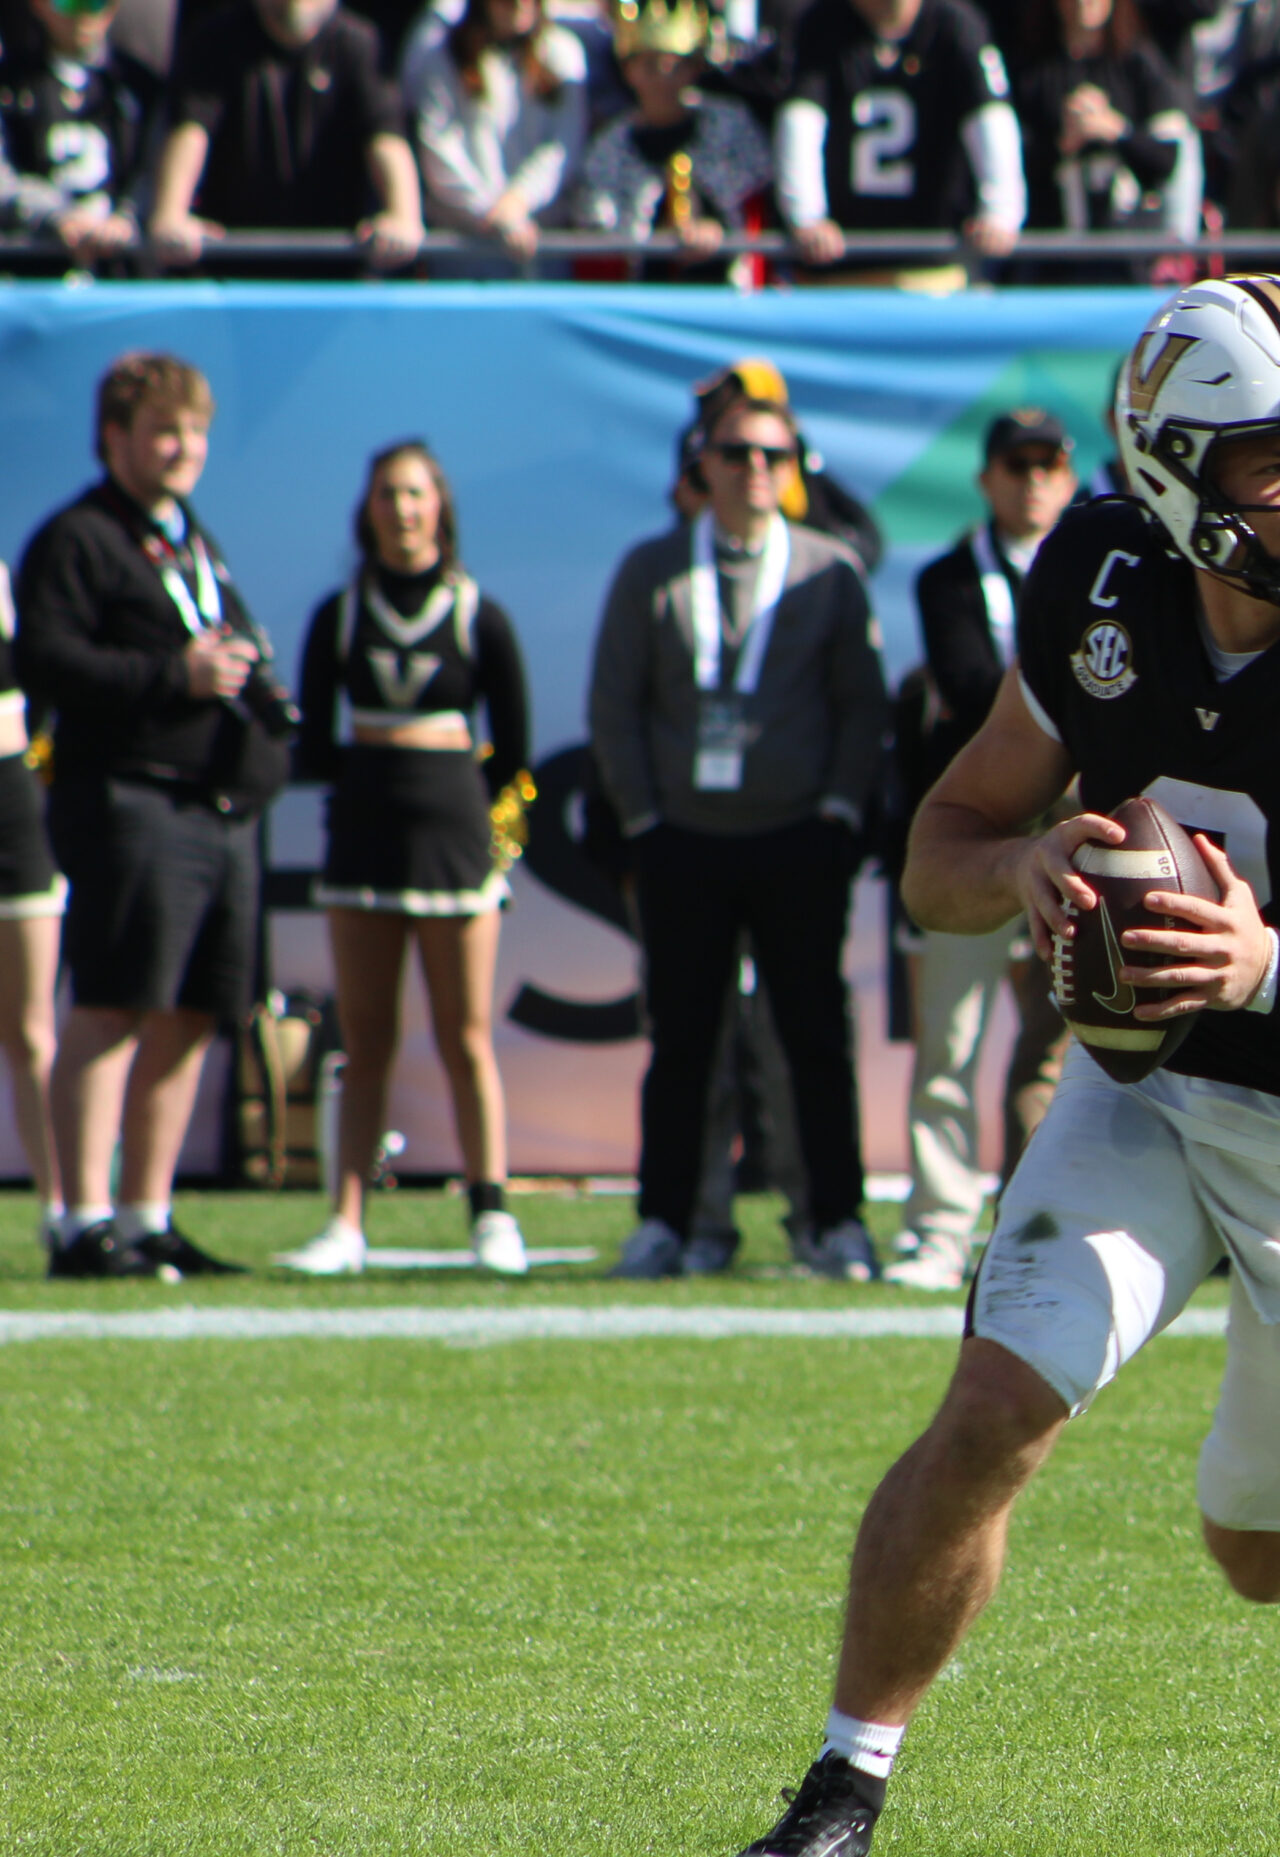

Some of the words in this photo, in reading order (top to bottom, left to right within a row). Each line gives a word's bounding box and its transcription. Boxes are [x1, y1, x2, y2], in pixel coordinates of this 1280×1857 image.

[852, 87, 916, 198] 2
[1127, 330, 1204, 412] V
[1088, 549, 1141, 608] C
[368, 648, 443, 707] V
[1086, 625, 1128, 679] SEC
[1194, 707, 1220, 731] V
[1157, 856, 1171, 875] QB
